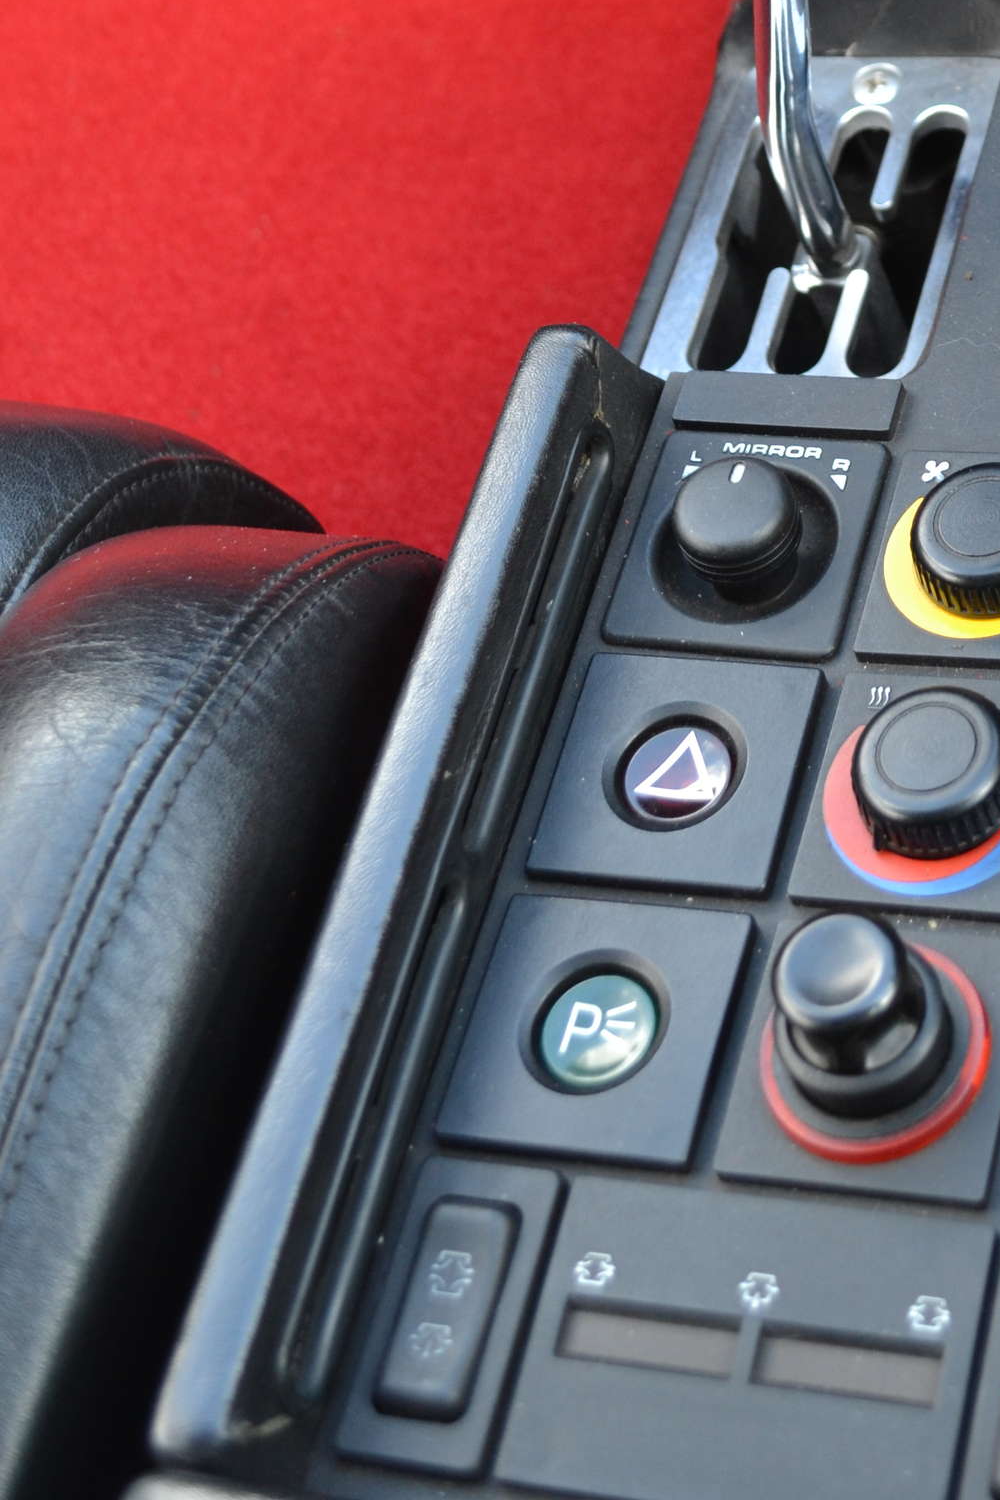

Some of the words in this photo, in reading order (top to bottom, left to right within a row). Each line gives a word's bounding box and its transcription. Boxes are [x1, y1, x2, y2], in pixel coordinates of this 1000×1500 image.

[690, 451, 702, 462] L
[723, 442, 823, 459] MIRROR
[832, 458, 851, 472] R
